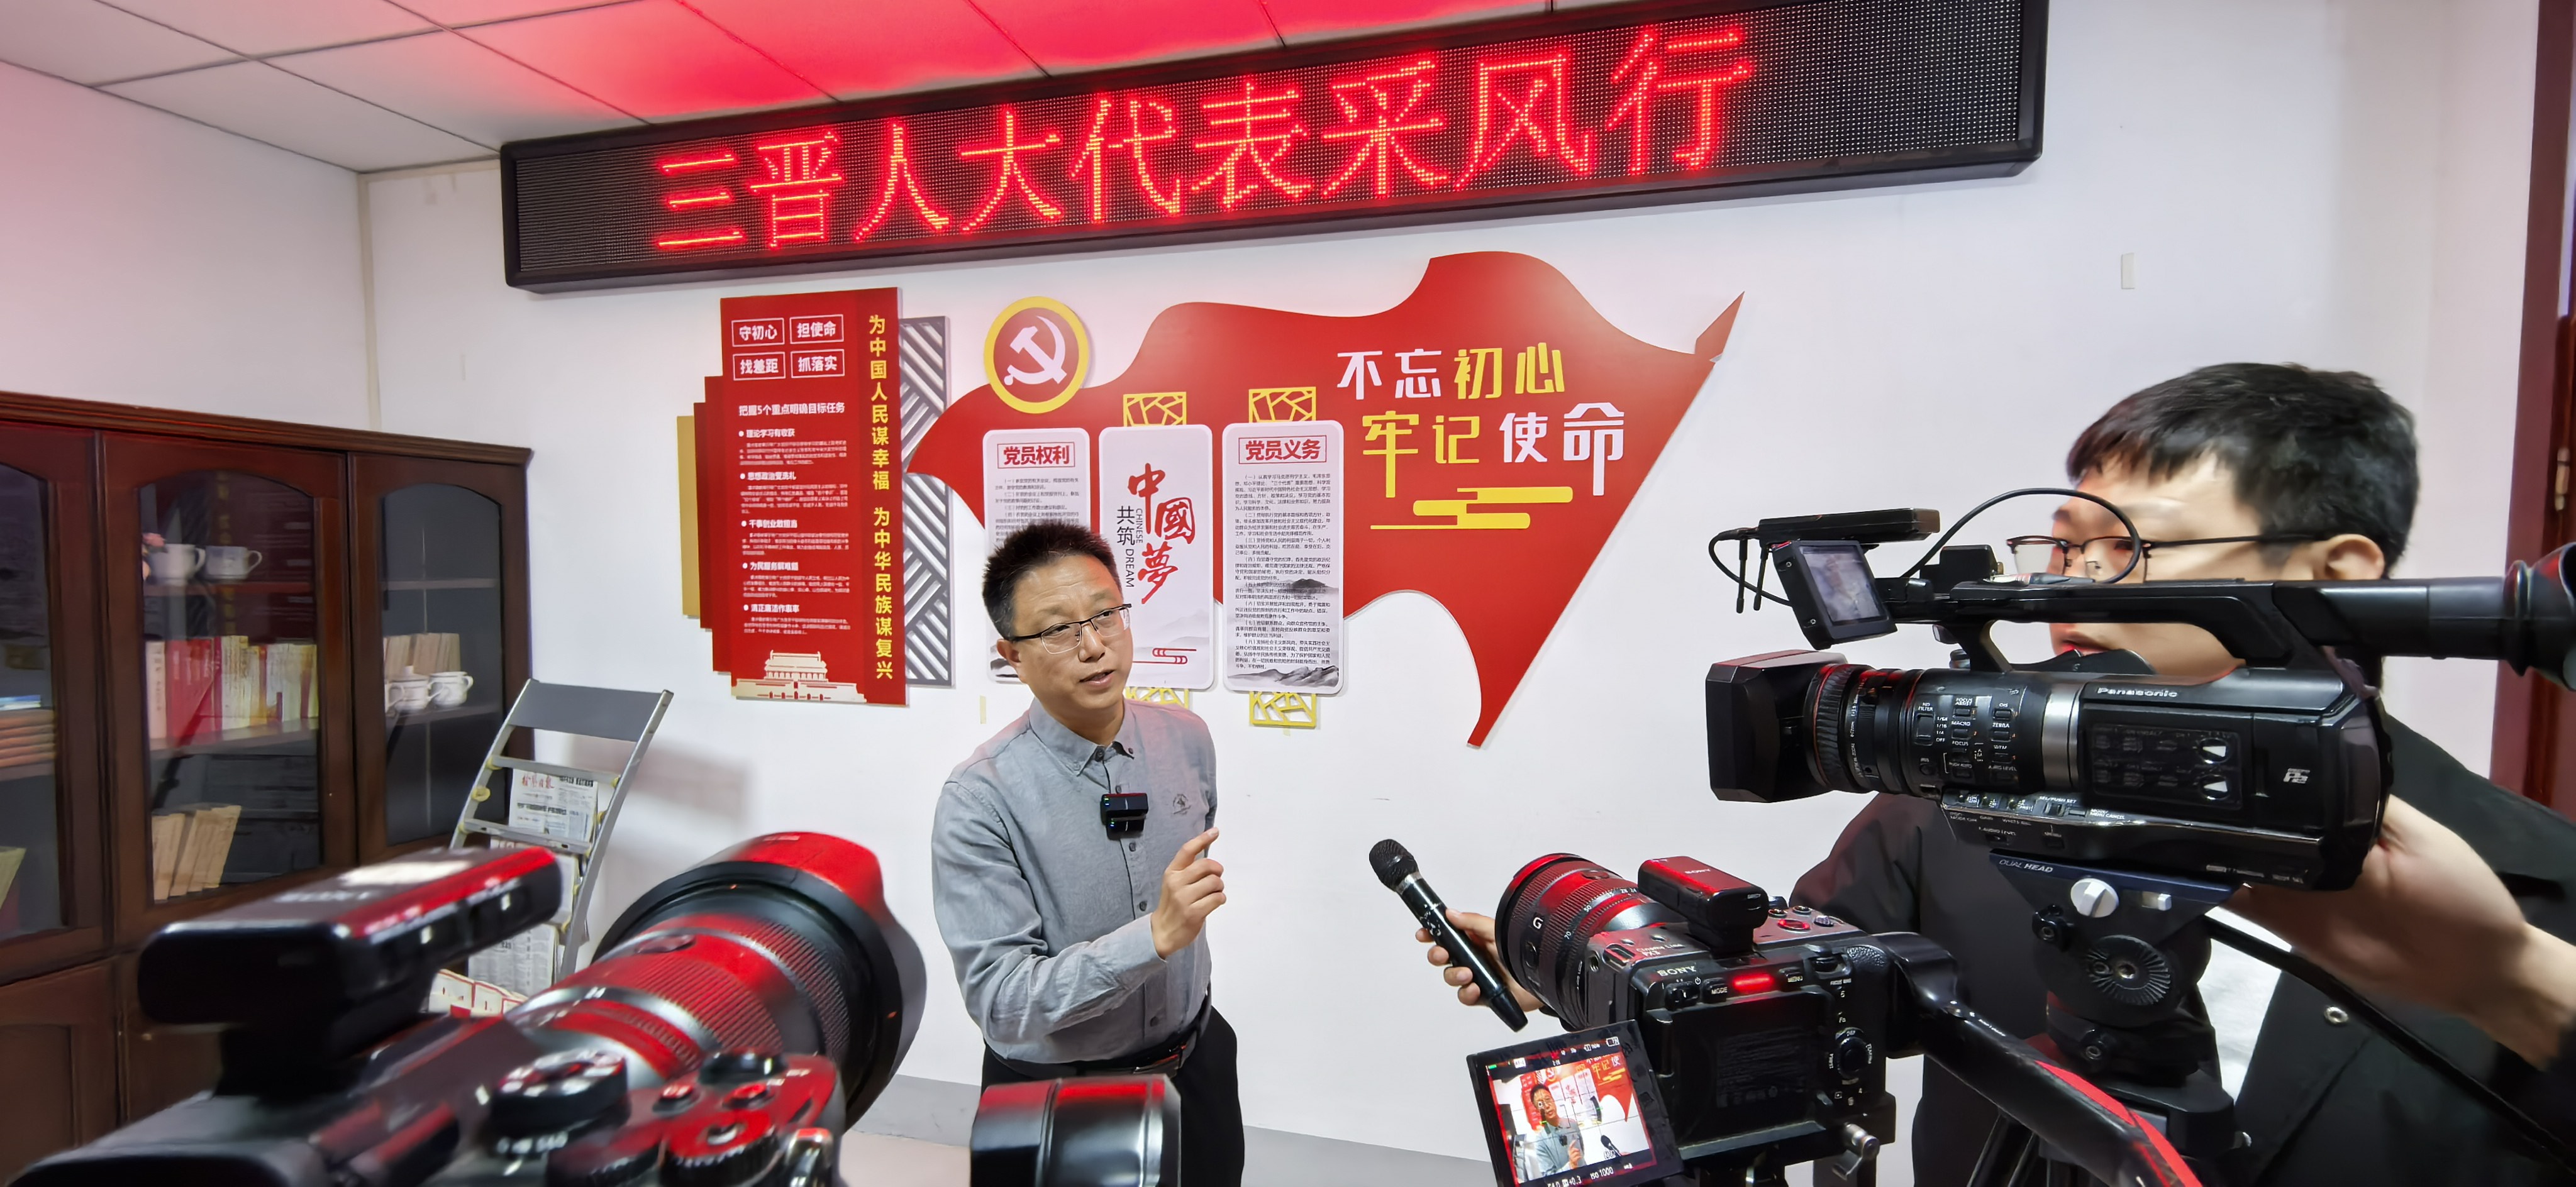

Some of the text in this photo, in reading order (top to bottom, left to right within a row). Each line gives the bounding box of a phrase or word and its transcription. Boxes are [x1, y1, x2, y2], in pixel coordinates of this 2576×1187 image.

[657, 29, 1751, 250] 三晋人大代表采风行
[739, 324, 778, 341] 守初心
[797, 321, 836, 338] 担使命
[740, 358, 779, 375] 找差距
[797, 355, 838, 372] 抓落实
[1336, 342, 1565, 400] 不忘初心
[738, 402, 845, 416] 把握5个重点明确目标任务
[1003, 445, 1070, 465] 党员权利
[1245, 439, 1321, 460] 党员义务
[1362, 402, 1625, 498] 牢记使命
[869, 314, 893, 680] 为中国人民谋幸福 为中华民族谋复兴
[1117, 505, 1135, 546] 共筑
[1125, 508, 1143, 588] CHINESE DREAM
[2097, 687, 2179, 698] Panasonic
[1999, 859, 2053, 873] DUAL HEAD
[1533, 917, 1544, 929] G
[1563, 931, 1572, 940] 70
[1657, 966, 1697, 976] SONY
[1590, 1172, 1599, 1180] ISO
[1599, 1166, 1614, 1179] 1000
